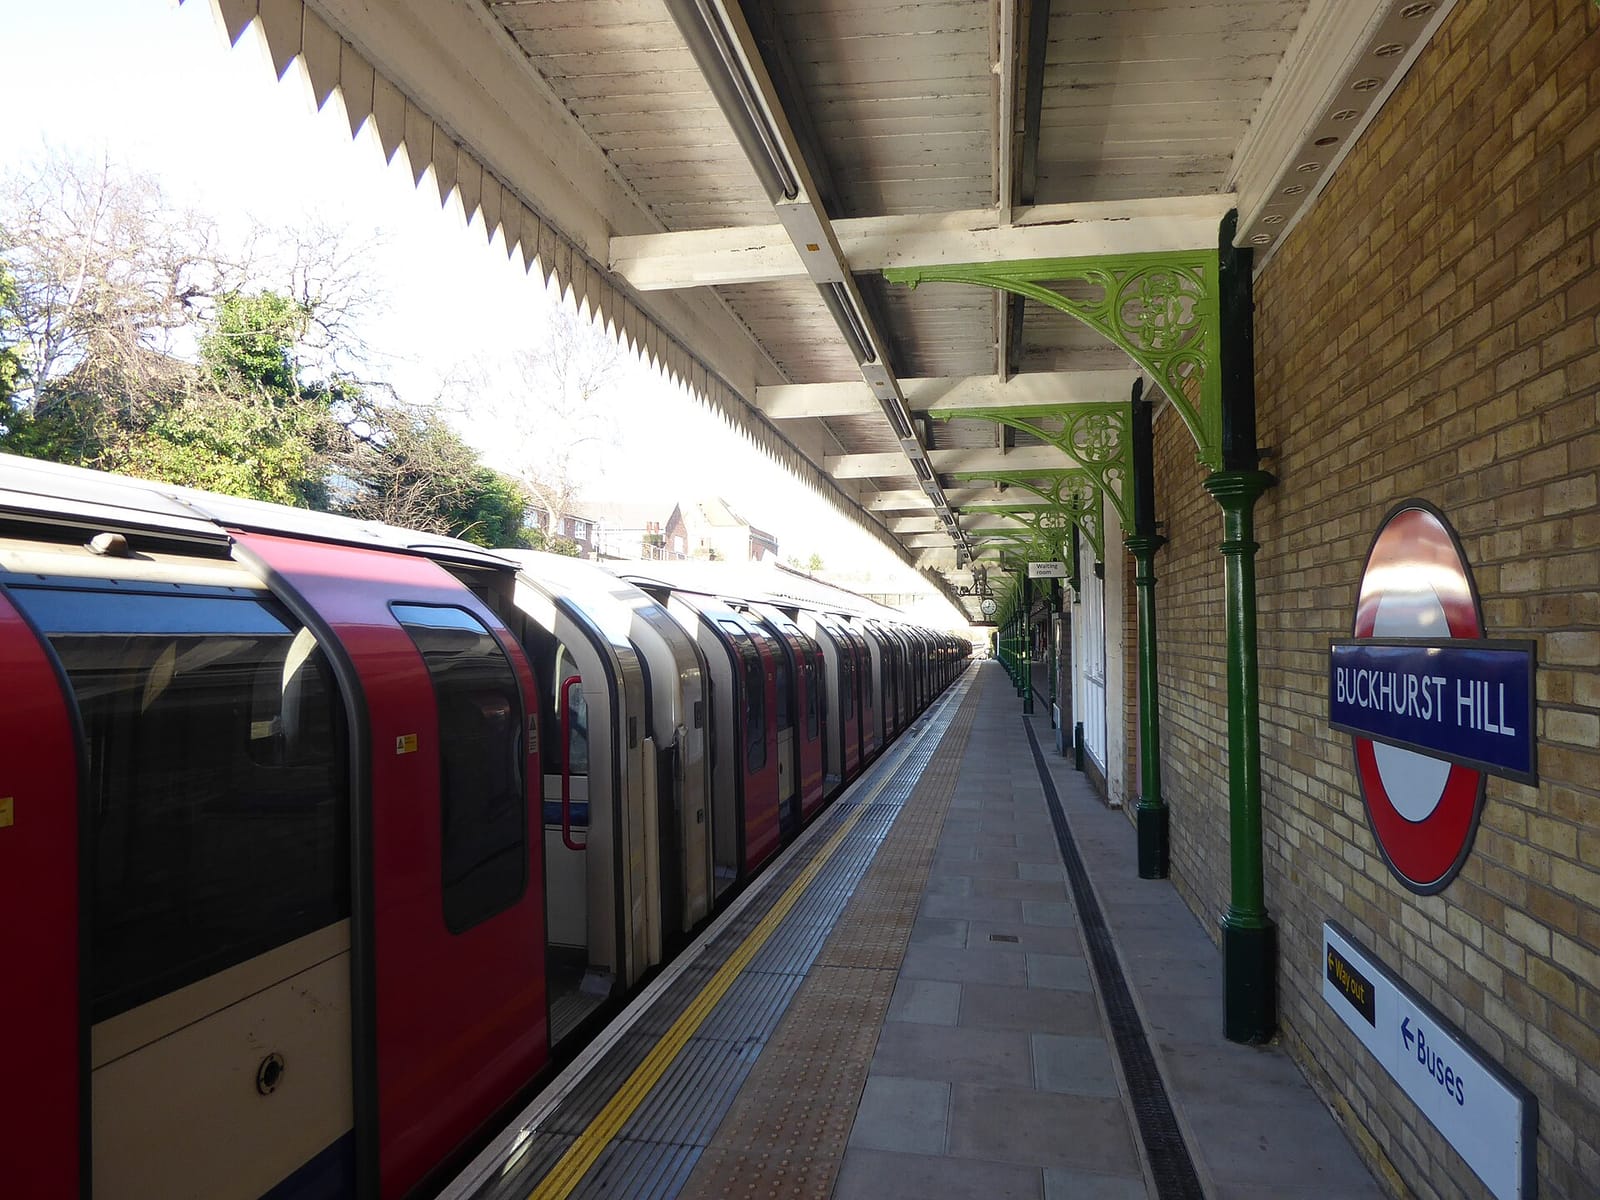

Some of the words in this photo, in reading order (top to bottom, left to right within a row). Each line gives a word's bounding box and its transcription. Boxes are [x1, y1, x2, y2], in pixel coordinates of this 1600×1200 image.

[1337, 667, 1447, 723] BUCKHURST
[1456, 679, 1516, 737] HILL
[1335, 957, 1351, 993] Way
[1350, 978, 1365, 1005] out
[1417, 1027, 1465, 1107] Buses
